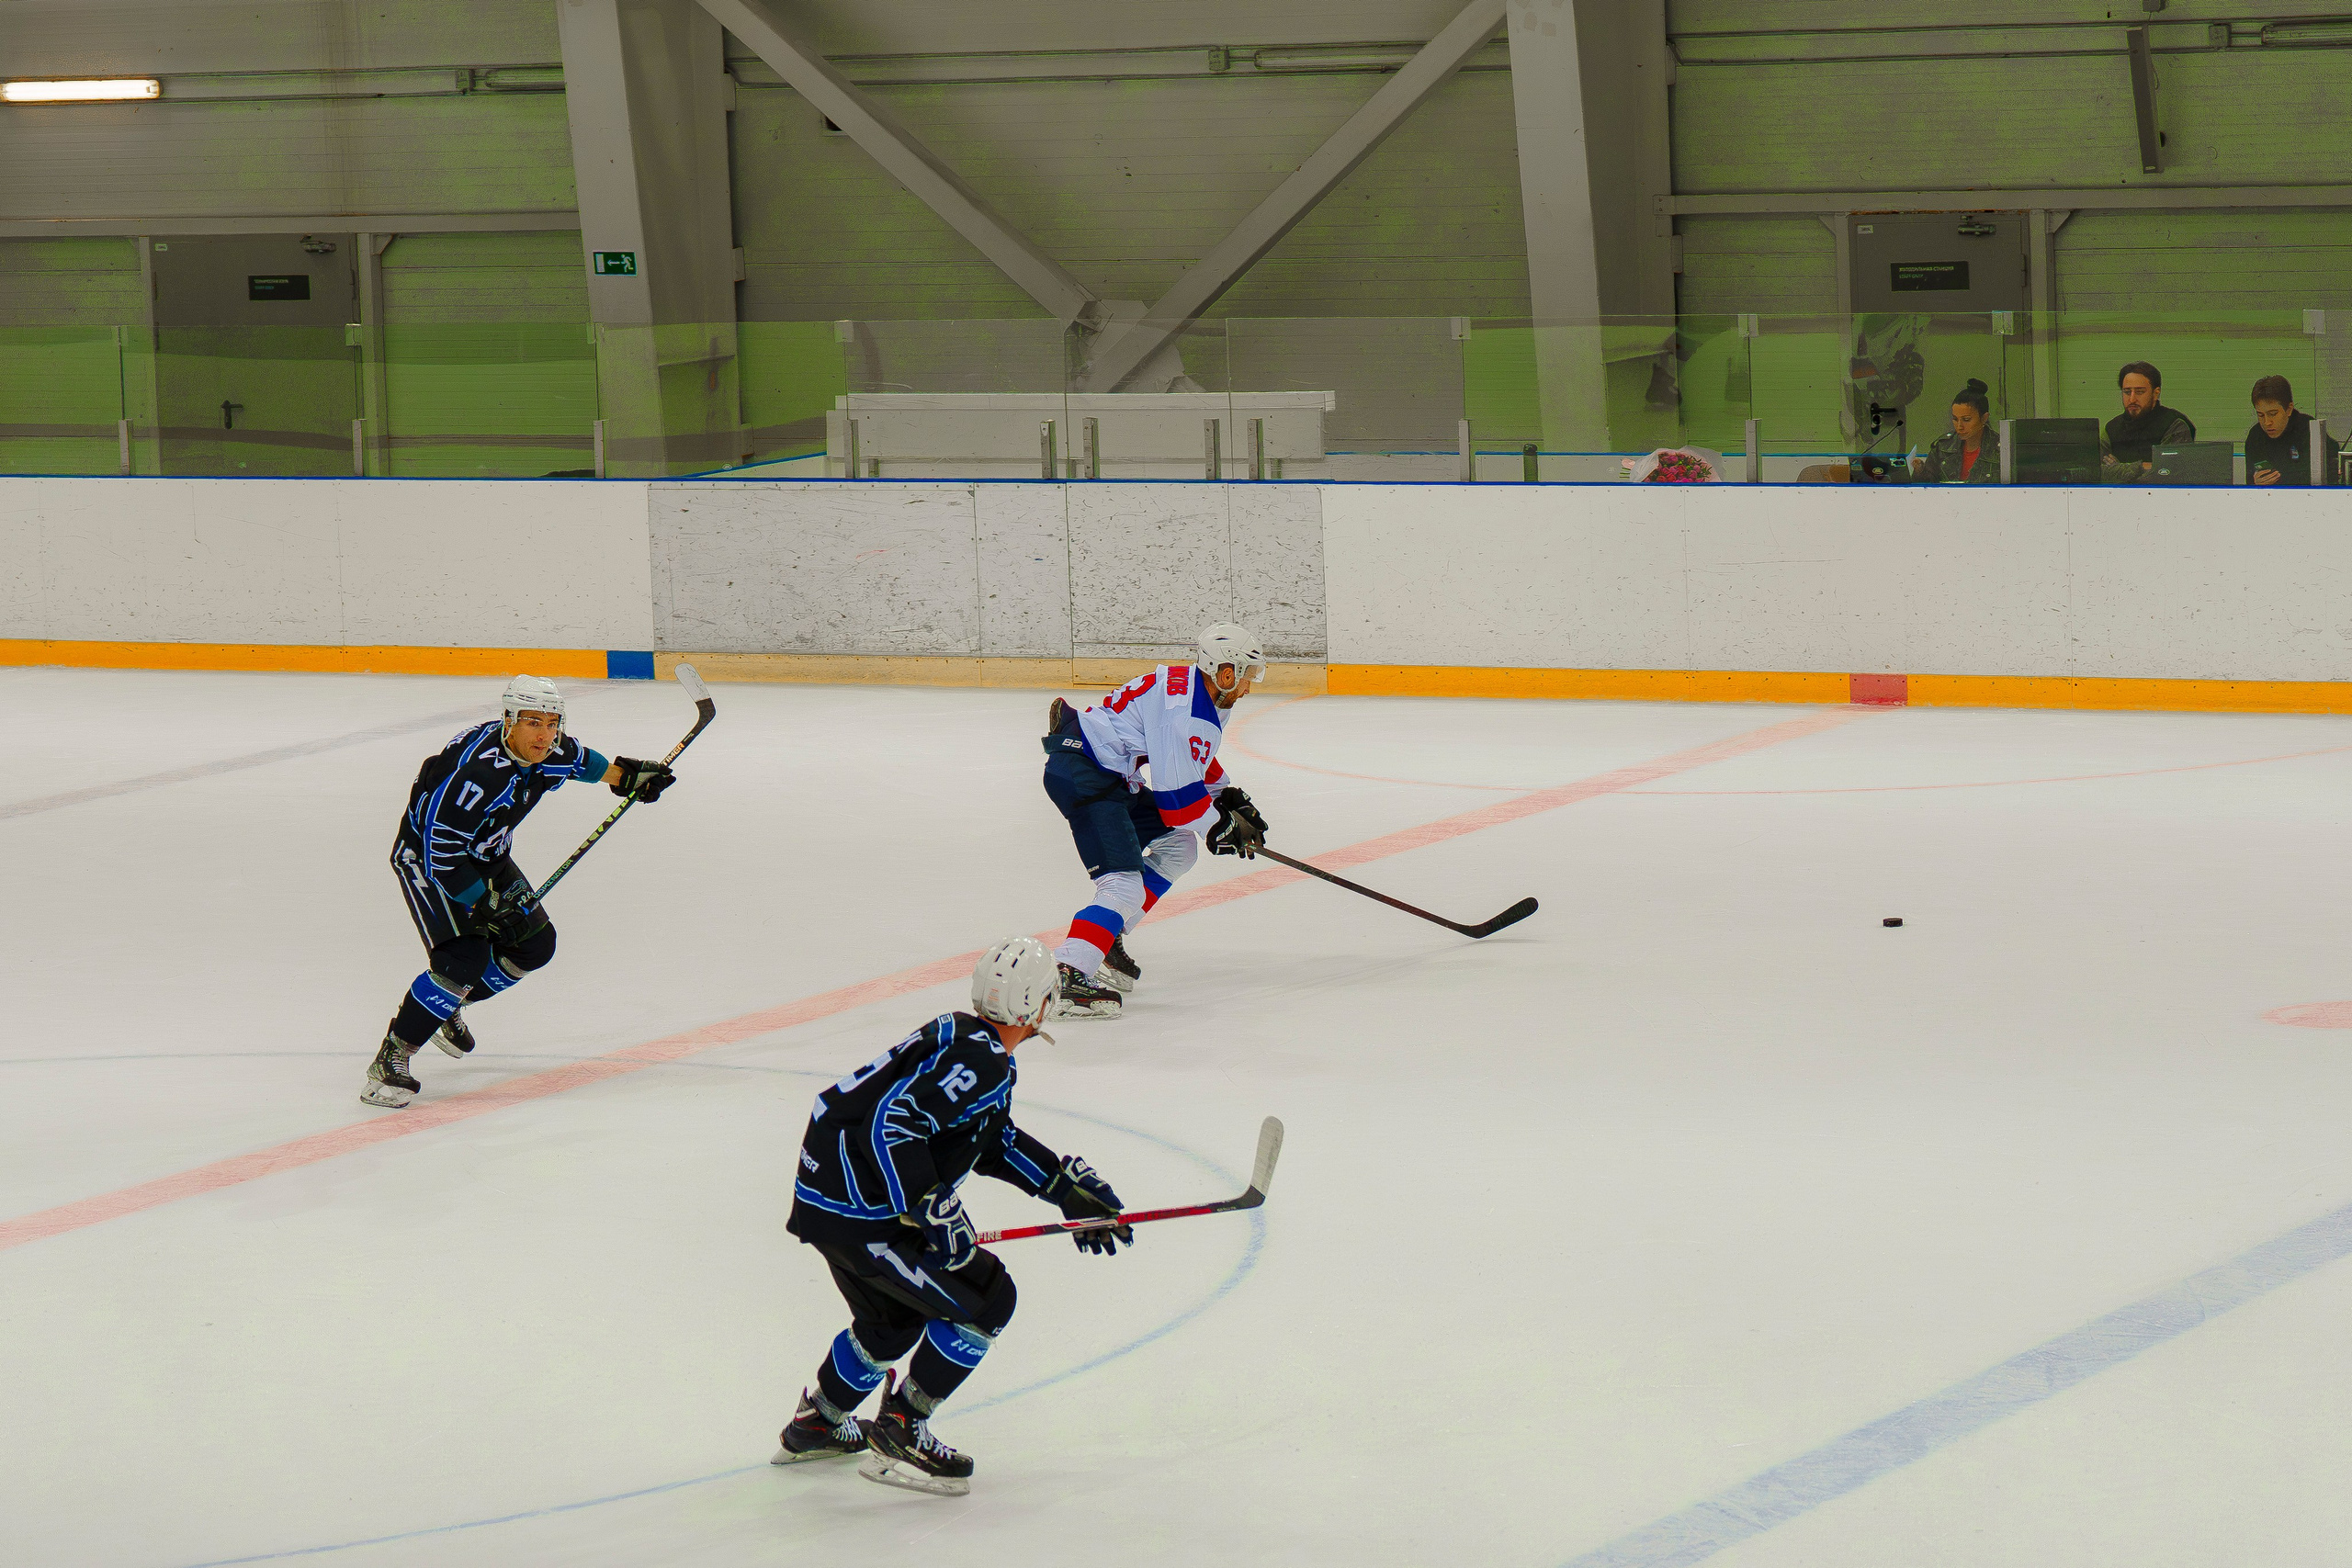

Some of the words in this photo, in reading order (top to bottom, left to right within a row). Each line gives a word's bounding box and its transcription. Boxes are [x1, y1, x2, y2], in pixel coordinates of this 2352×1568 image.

[1189, 735, 1212, 765] 63
[456, 780, 484, 811] 17
[533, 858, 574, 899] DOMINATOR
[937, 1063, 978, 1102] 12
